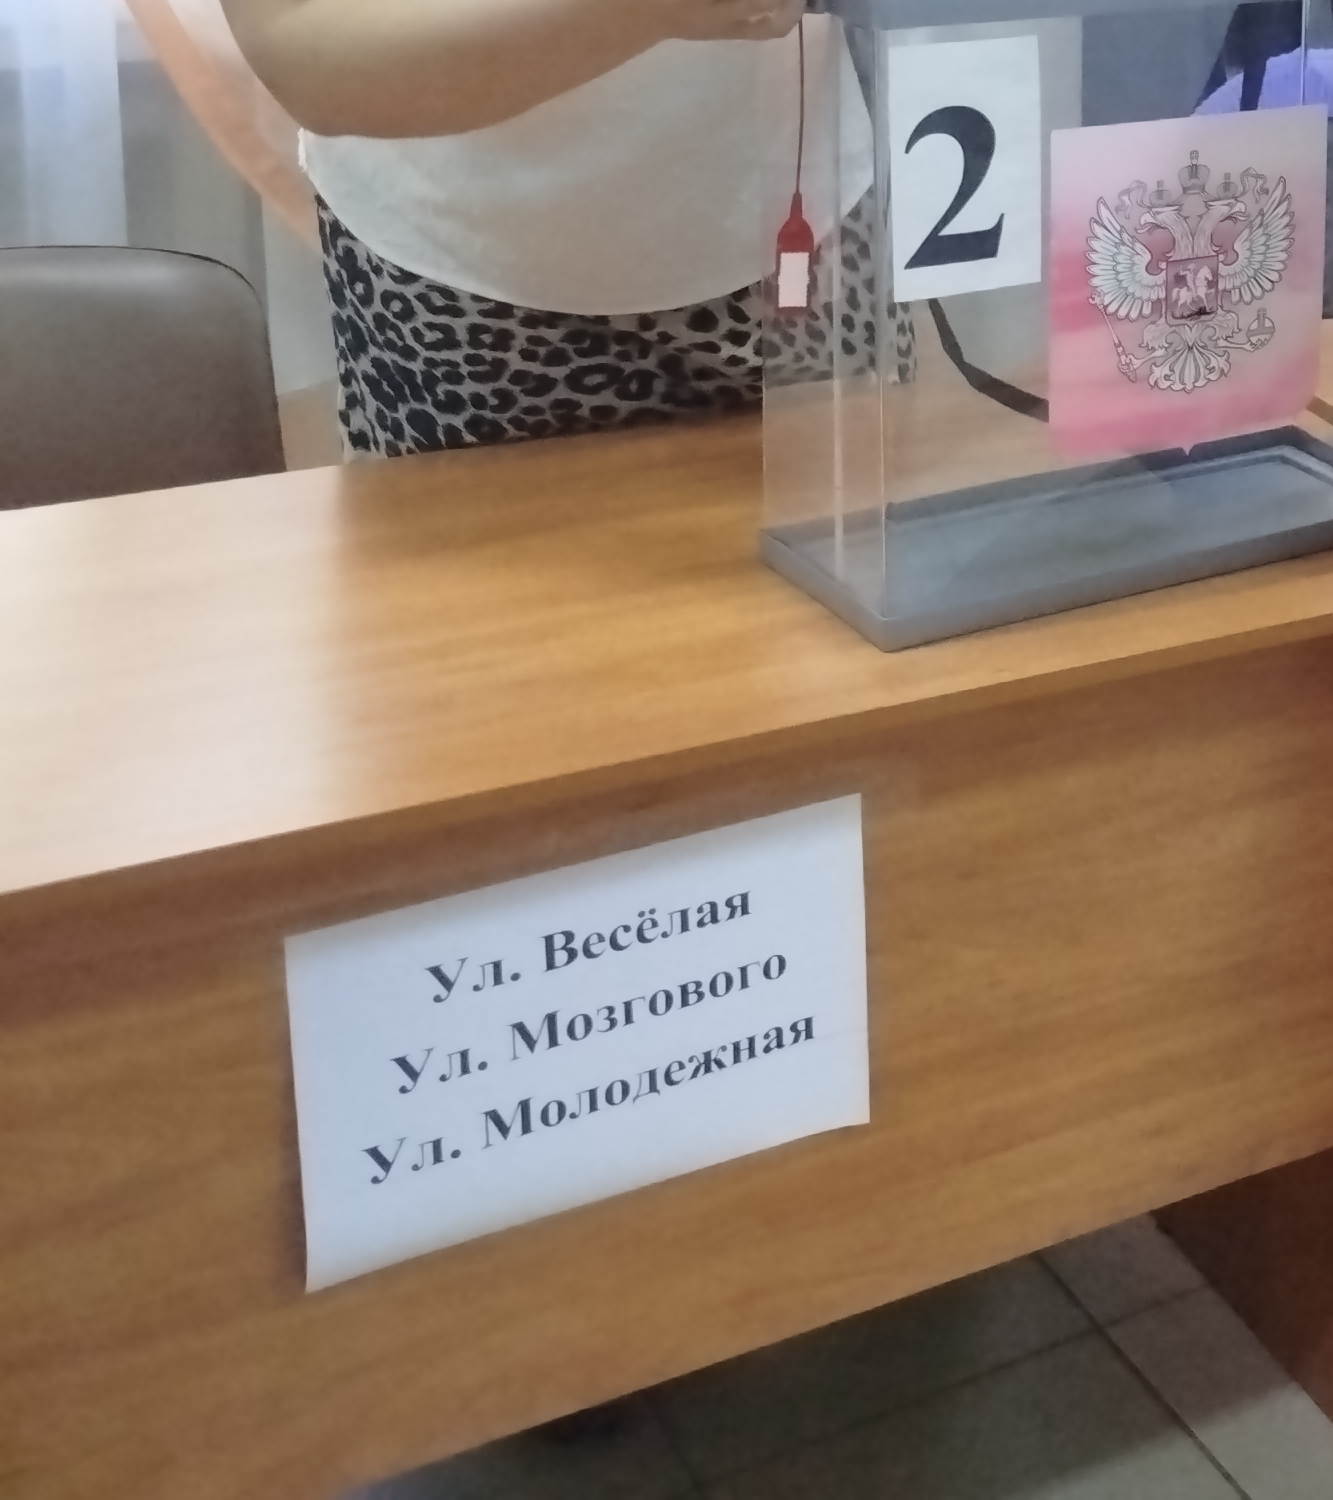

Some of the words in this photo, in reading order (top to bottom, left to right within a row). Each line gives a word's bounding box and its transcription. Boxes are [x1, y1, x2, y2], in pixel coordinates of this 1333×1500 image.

[904, 105, 1005, 271] 2
[389, 1048, 489, 1095] Ул.
[507, 953, 788, 1062] Мозгового
[424, 956, 522, 1004] Ул.
[539, 890, 752, 973] Весёлая
[361, 1137, 462, 1185] Ул.
[480, 1015, 816, 1150] Молодежная
